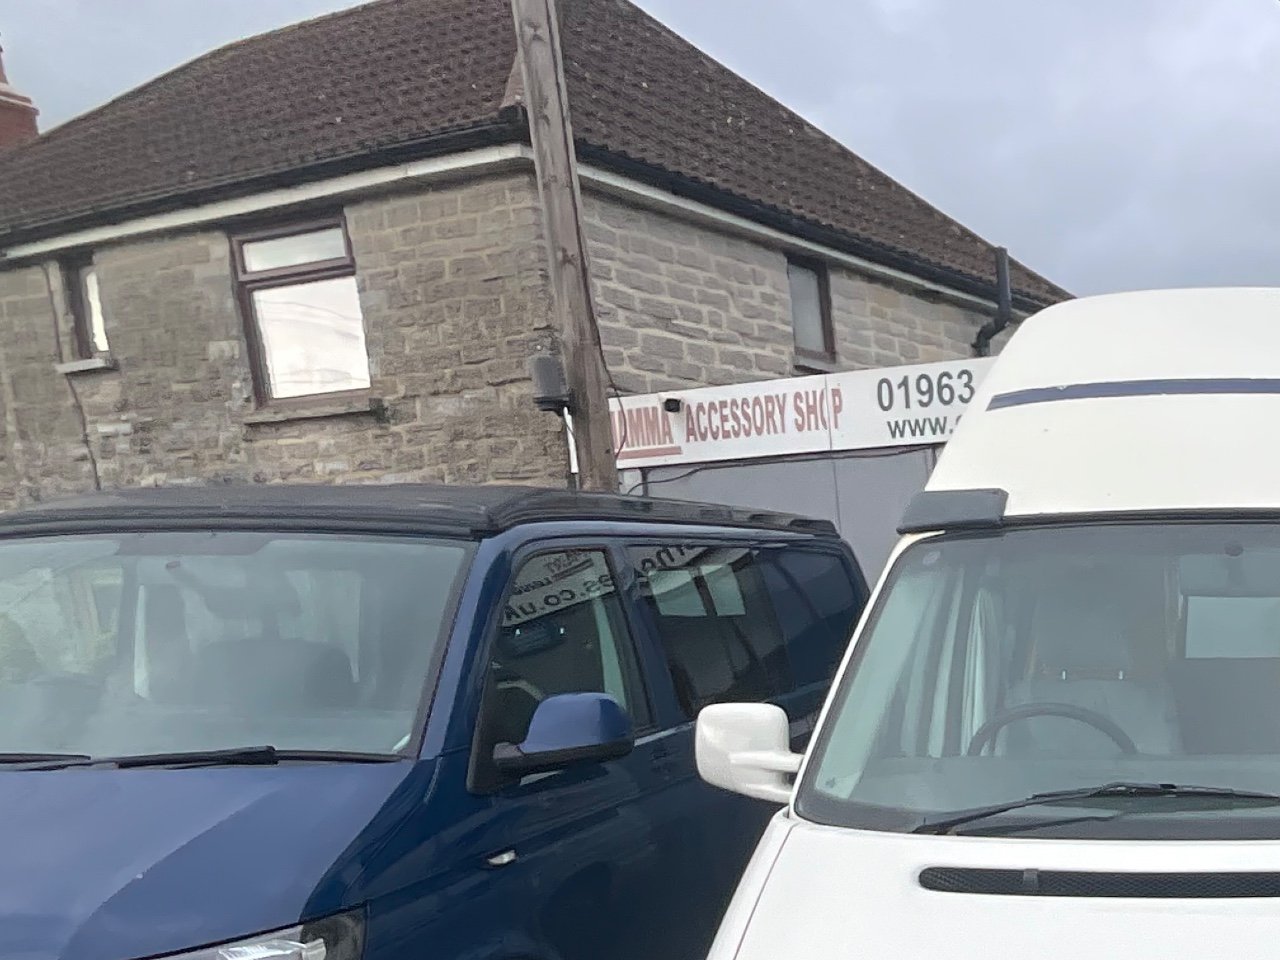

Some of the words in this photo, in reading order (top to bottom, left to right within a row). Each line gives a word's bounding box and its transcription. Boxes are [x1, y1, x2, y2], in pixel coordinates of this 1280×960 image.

[877, 368, 976, 412] 01963
[685, 392, 787, 442] ACCESSORY
[886, 414, 963, 439] www.
